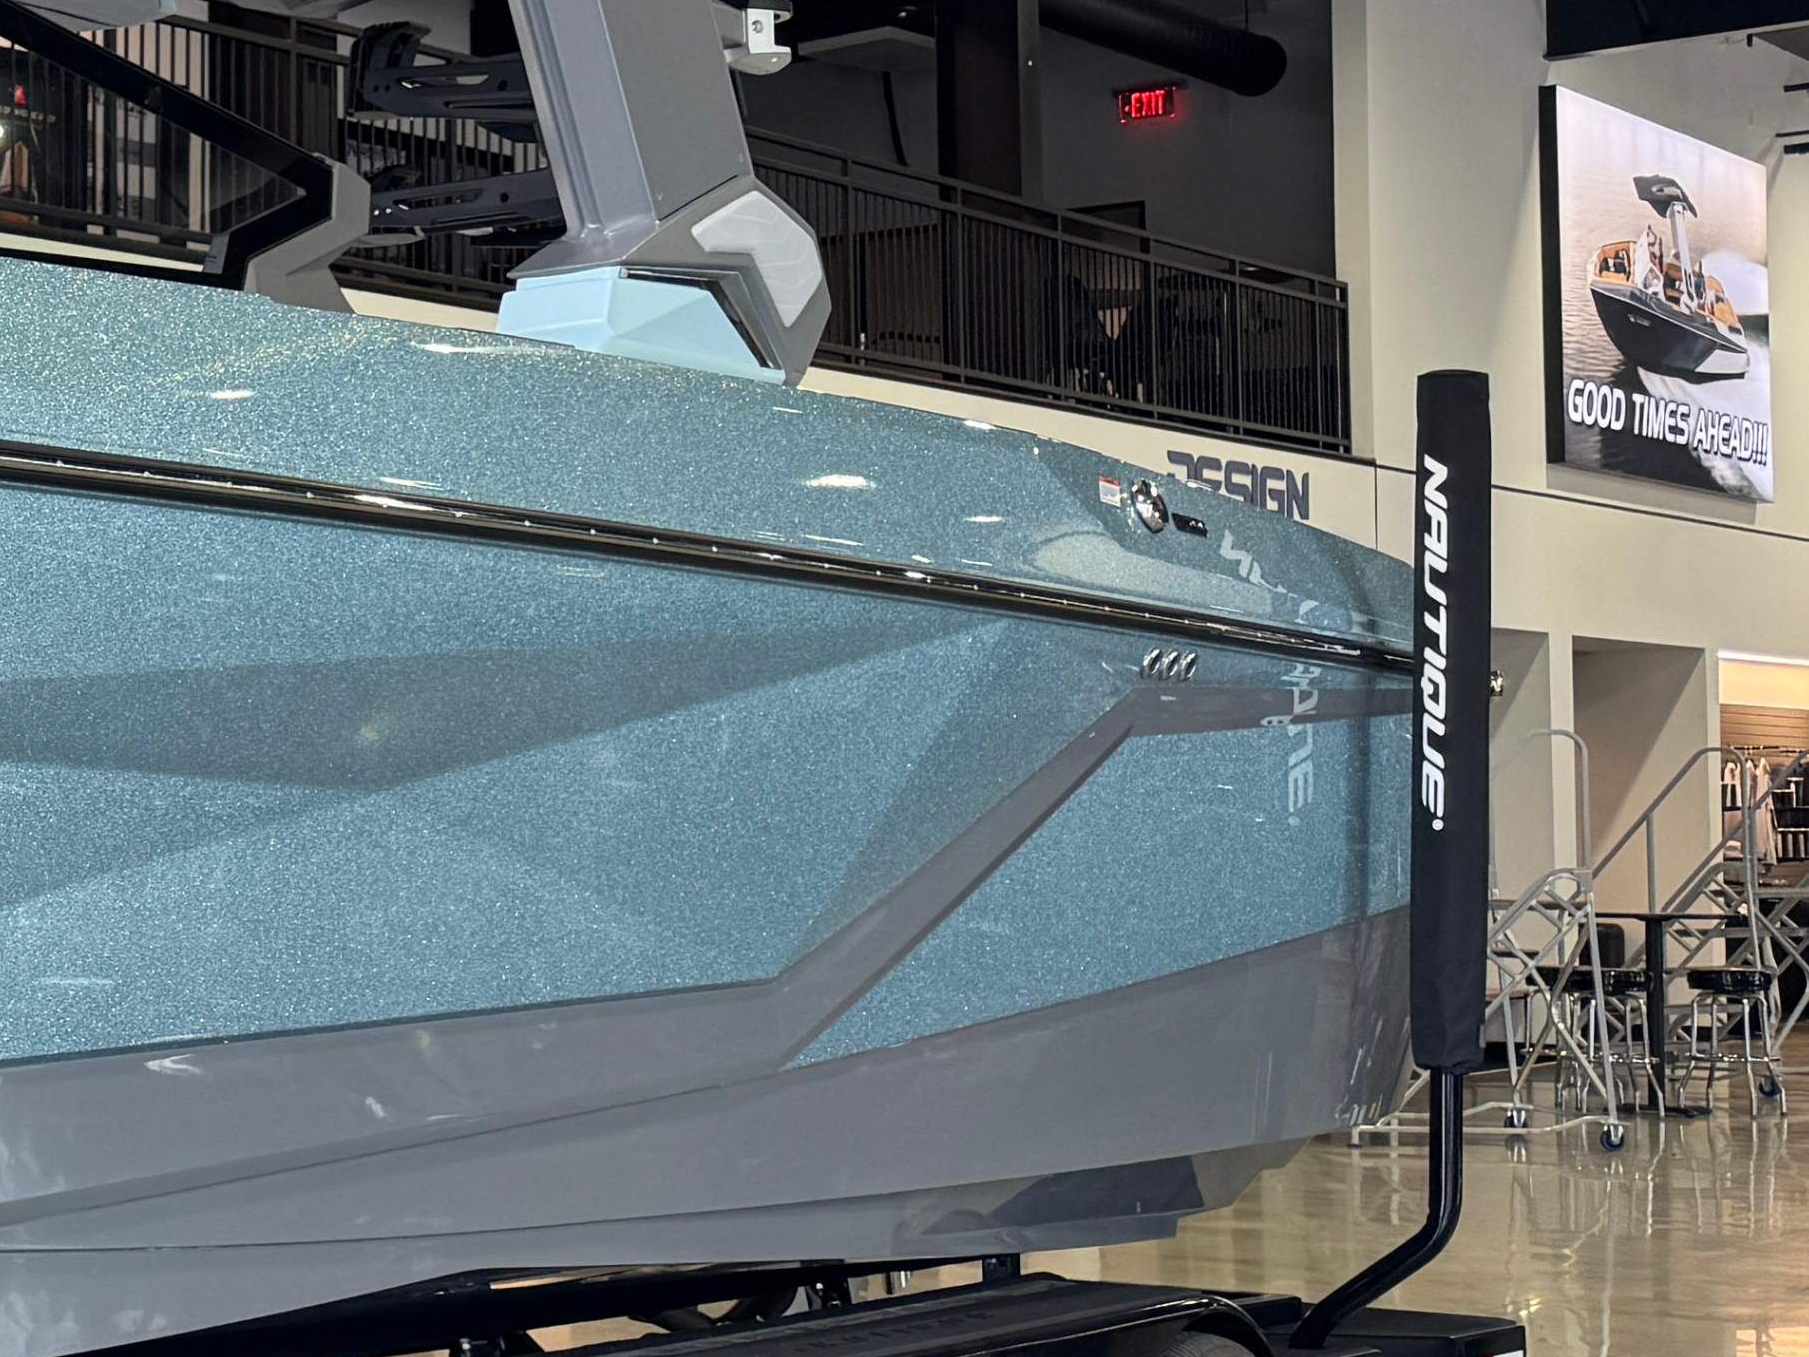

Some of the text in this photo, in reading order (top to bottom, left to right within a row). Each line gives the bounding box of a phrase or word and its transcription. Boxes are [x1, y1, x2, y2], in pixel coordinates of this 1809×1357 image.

[1131, 90, 1165, 118] EXIT
[1568, 379, 1769, 466] GOOD TIMES AHEAD!!!
[1420, 454, 1450, 816] NAUTIQUE
